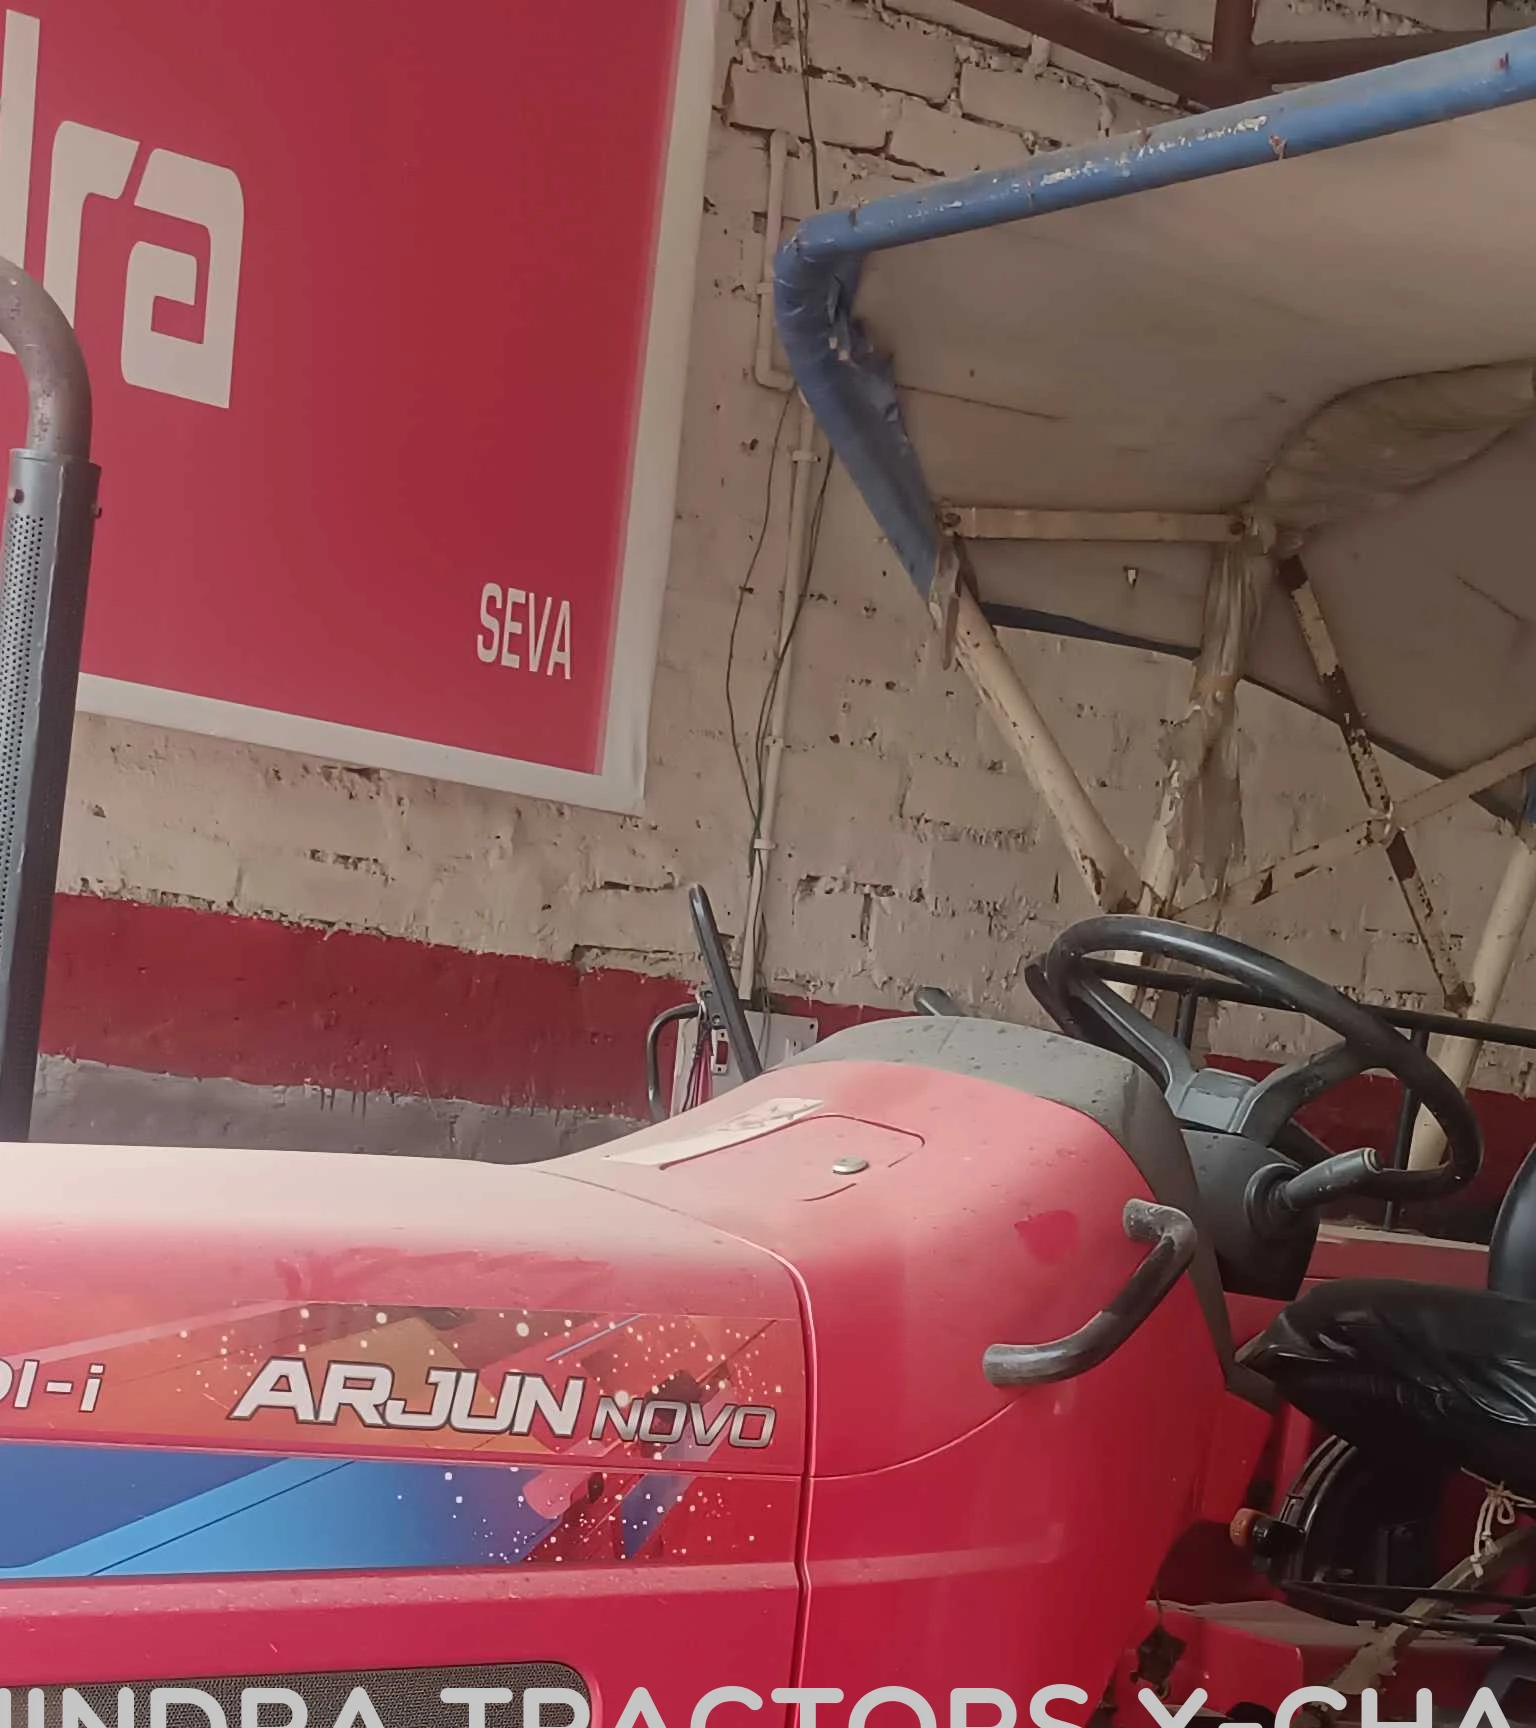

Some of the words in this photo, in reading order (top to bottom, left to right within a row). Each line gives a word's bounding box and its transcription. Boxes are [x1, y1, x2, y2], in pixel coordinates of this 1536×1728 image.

[476, 582, 572, 680] SEVA
[228, 1356, 586, 1437] ARJUN
[590, 1395, 777, 1449] NOVO
